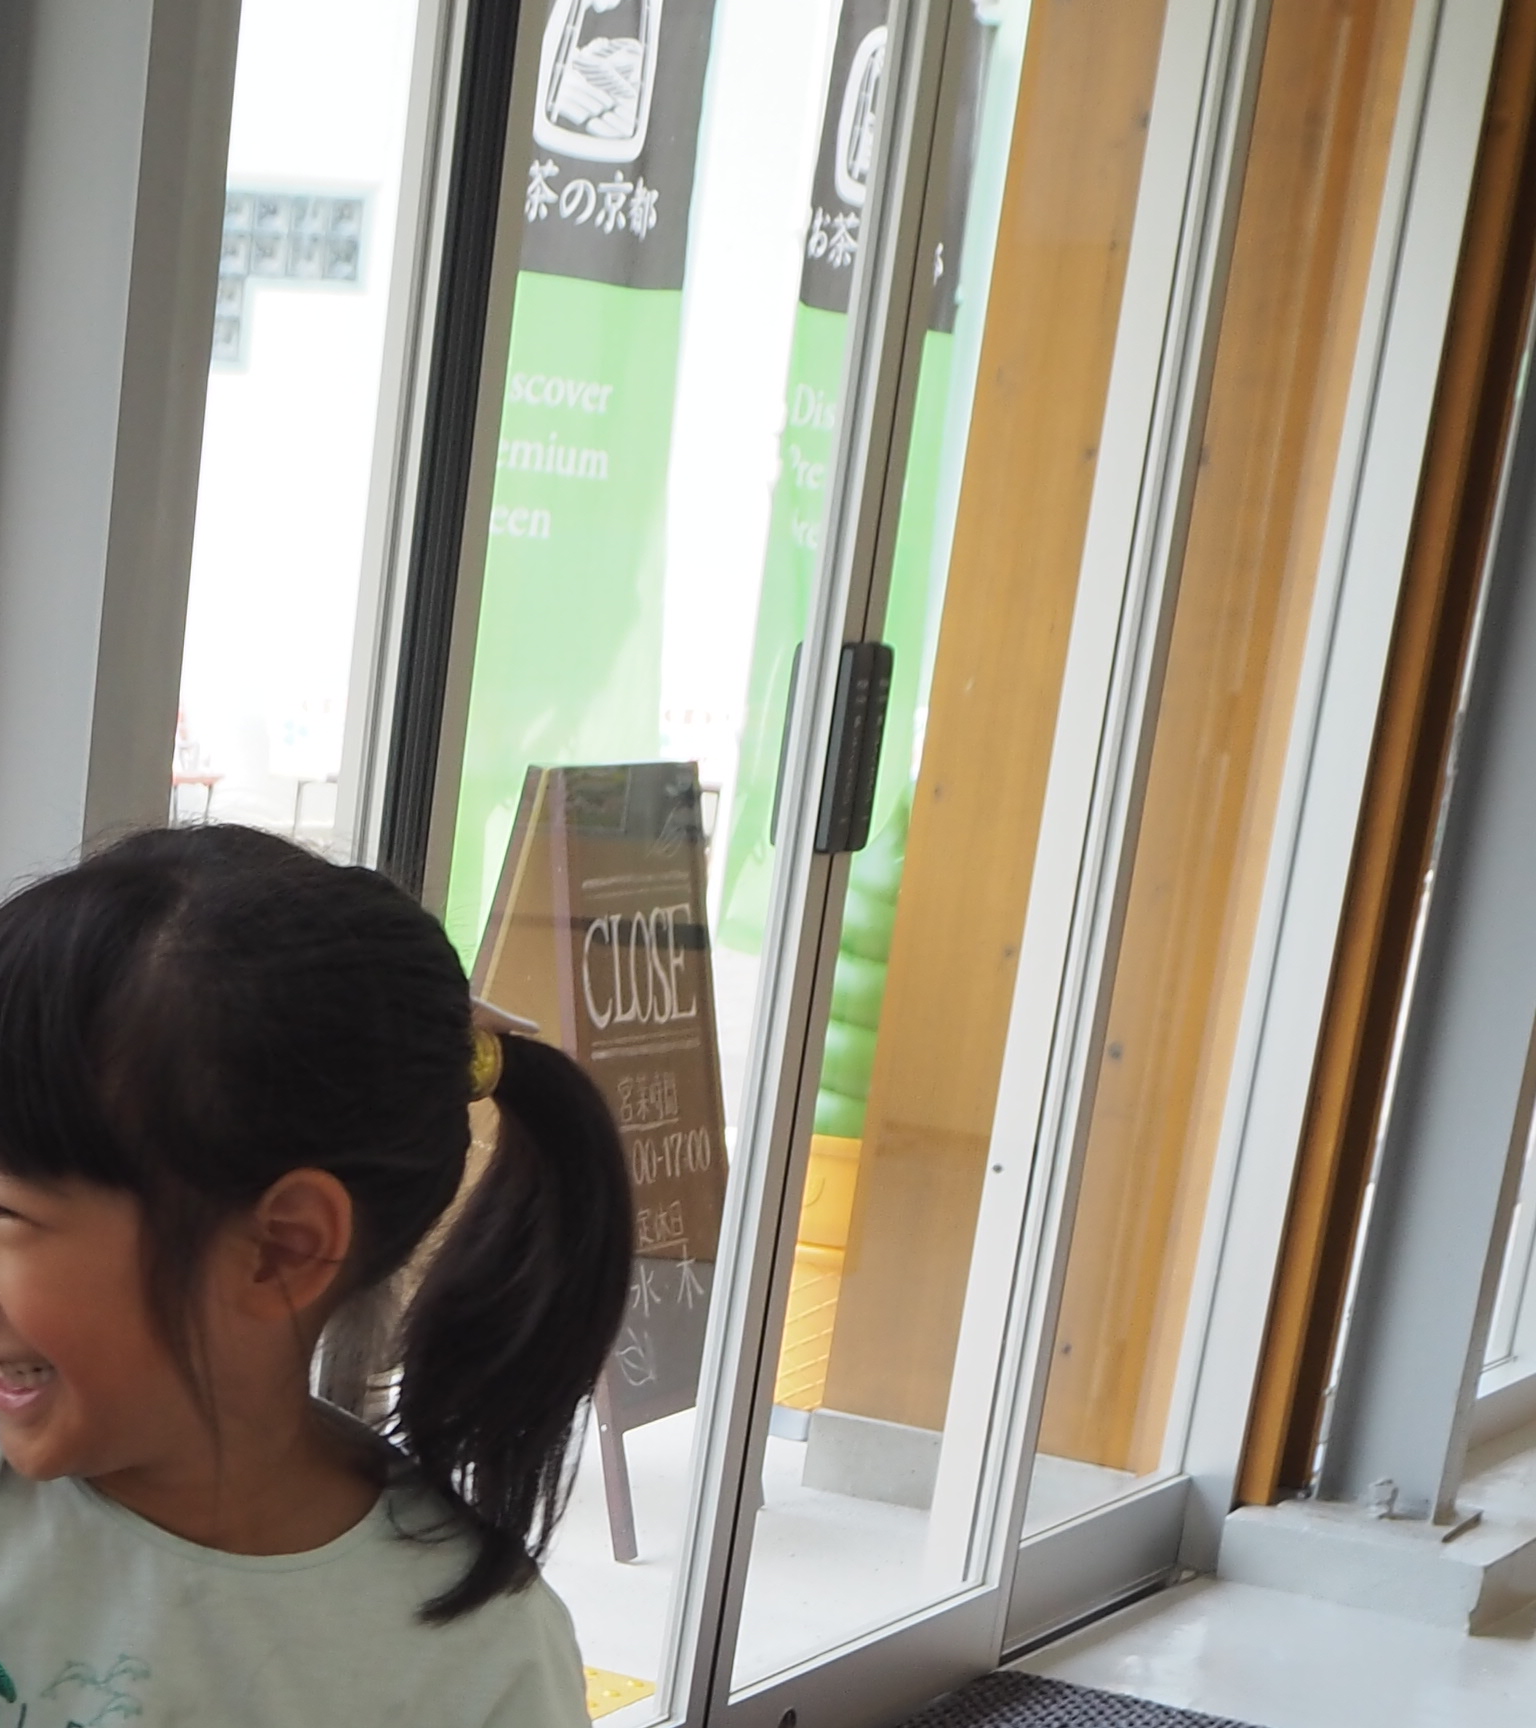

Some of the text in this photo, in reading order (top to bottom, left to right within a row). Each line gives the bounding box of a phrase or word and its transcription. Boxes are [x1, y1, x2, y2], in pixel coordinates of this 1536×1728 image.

[524, 158, 660, 243] 茶の京都
[509, 371, 614, 416] scover
[497, 431, 609, 481] emium
[489, 504, 552, 540] een
[582, 903, 698, 1029] CLOSE
[632, 1125, 711, 1185] 00-17:00
